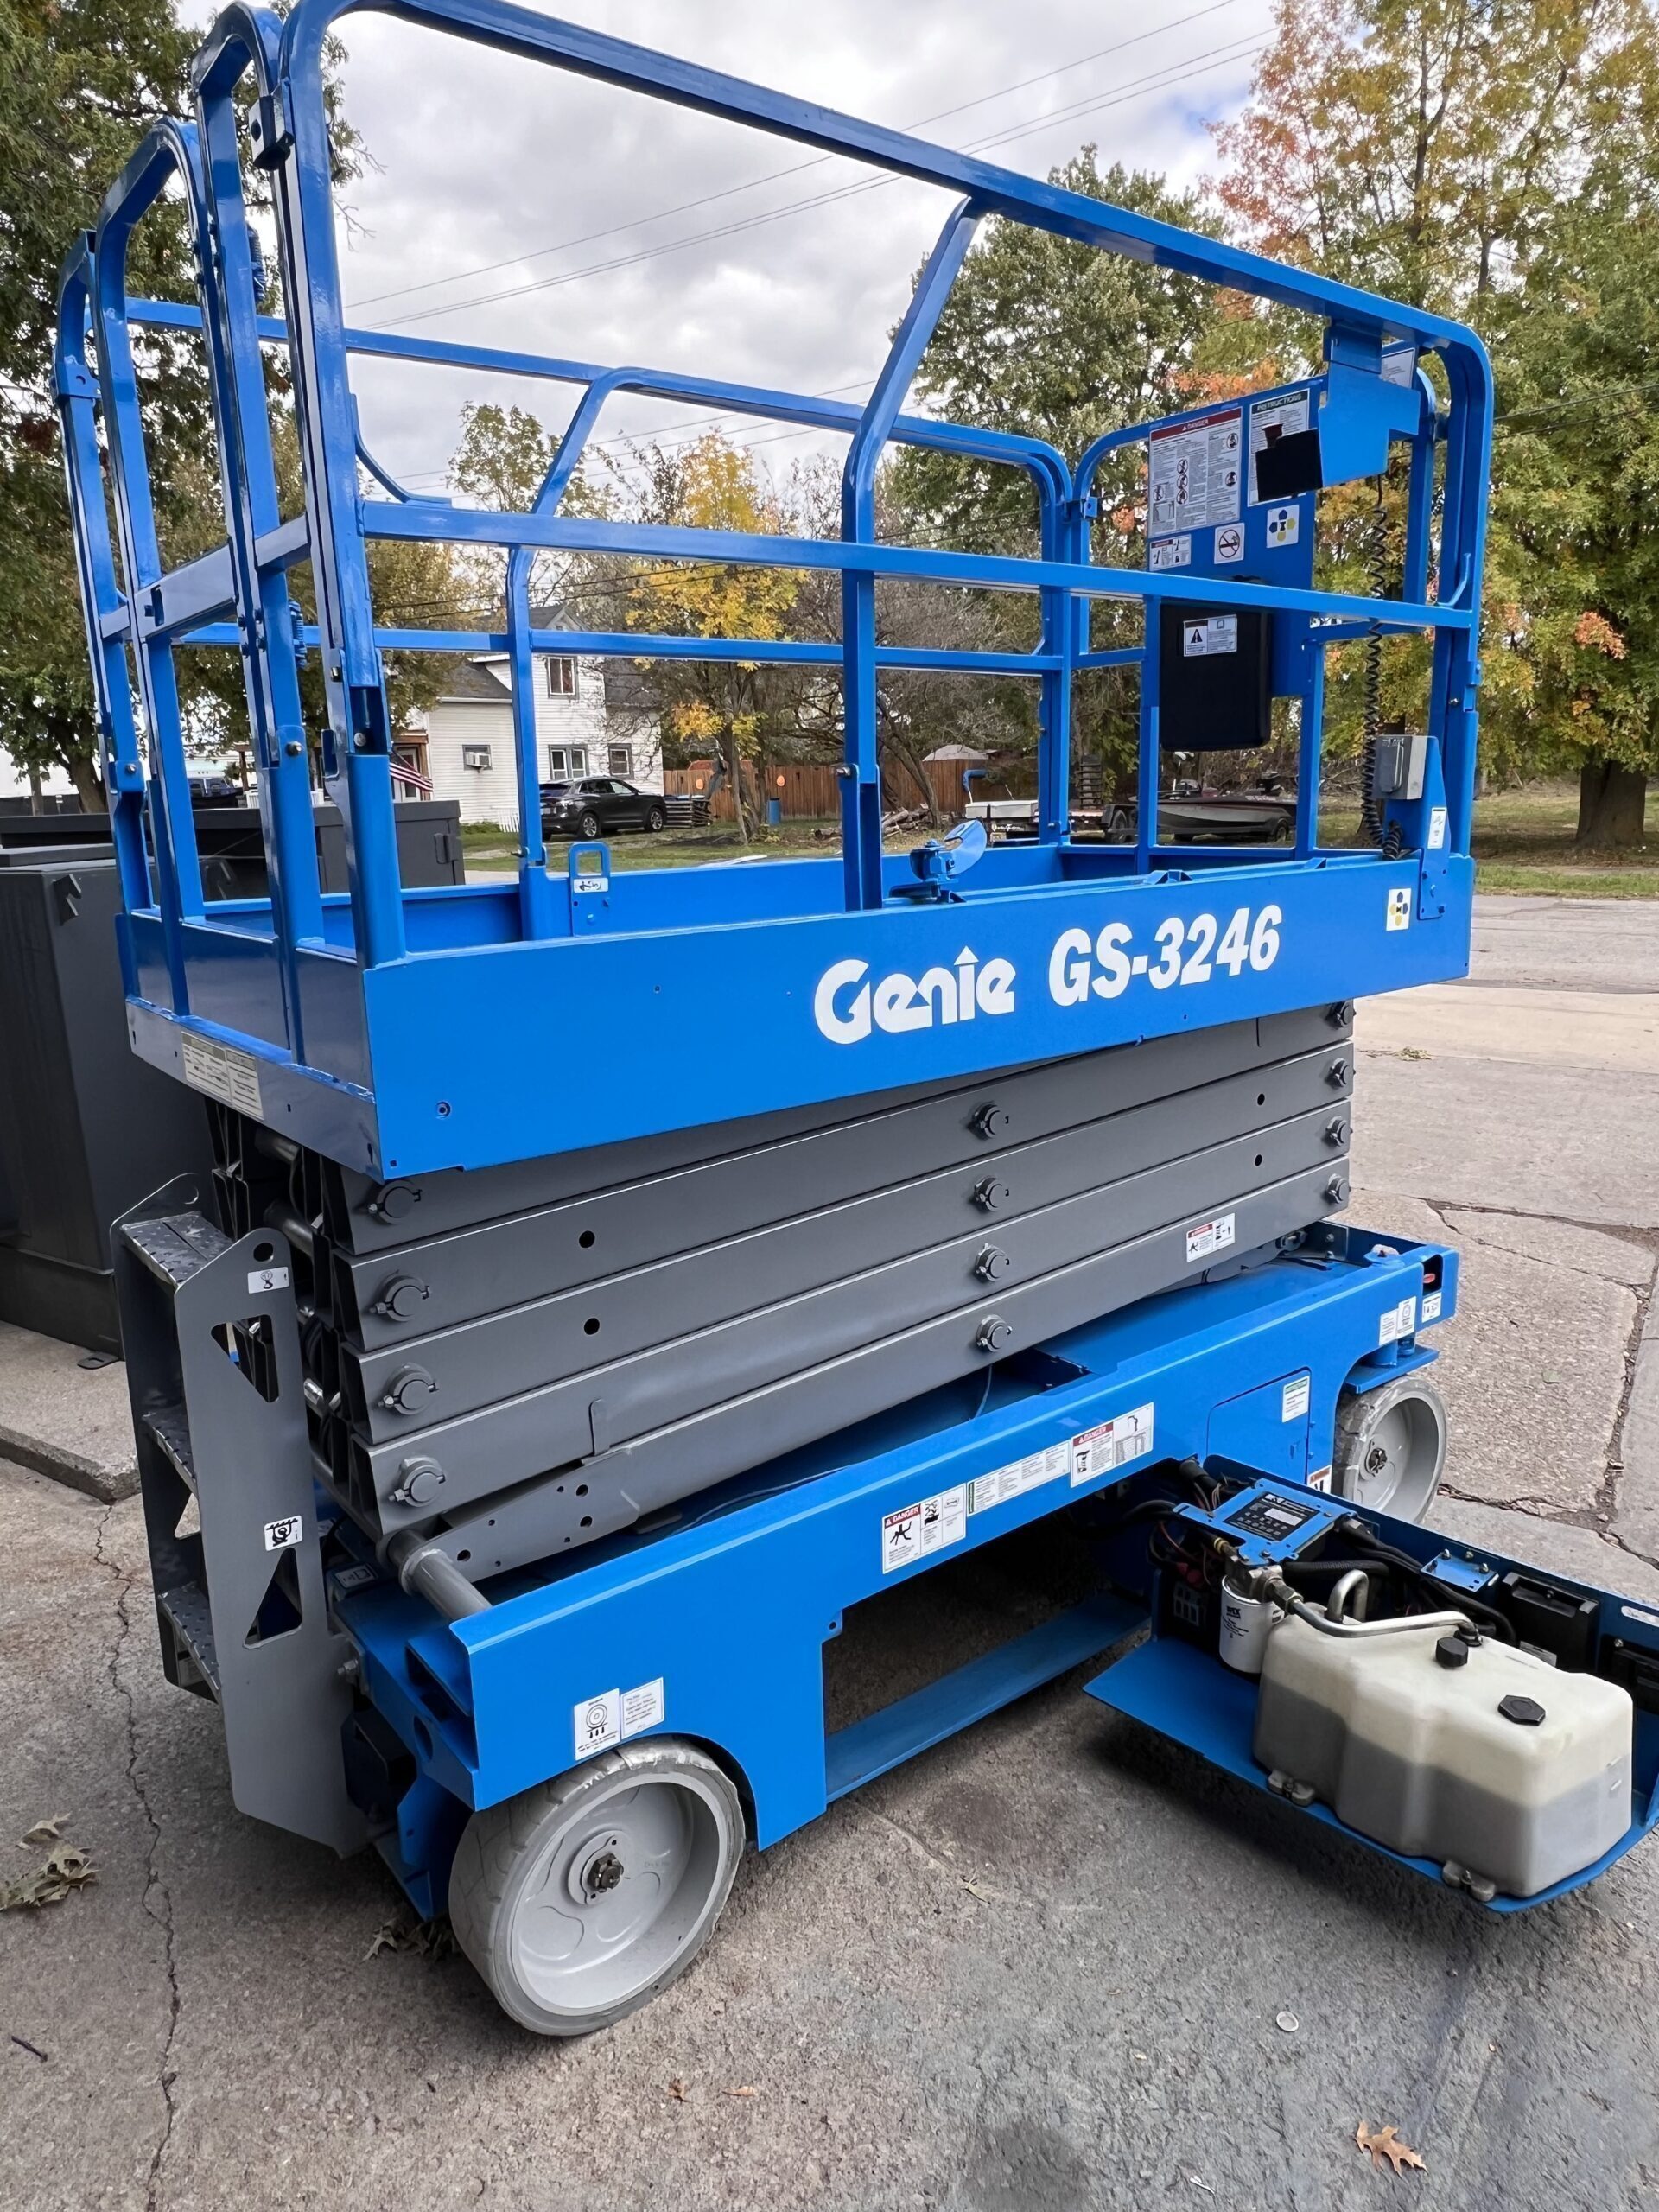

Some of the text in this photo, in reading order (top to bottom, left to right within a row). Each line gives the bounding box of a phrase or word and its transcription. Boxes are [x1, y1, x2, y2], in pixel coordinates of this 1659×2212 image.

[1257, 394, 1301, 411] INSTRUCTIONS
[815, 905, 1281, 1044] Genie GS-3246
[893, 1506, 918, 1522] DANGER
